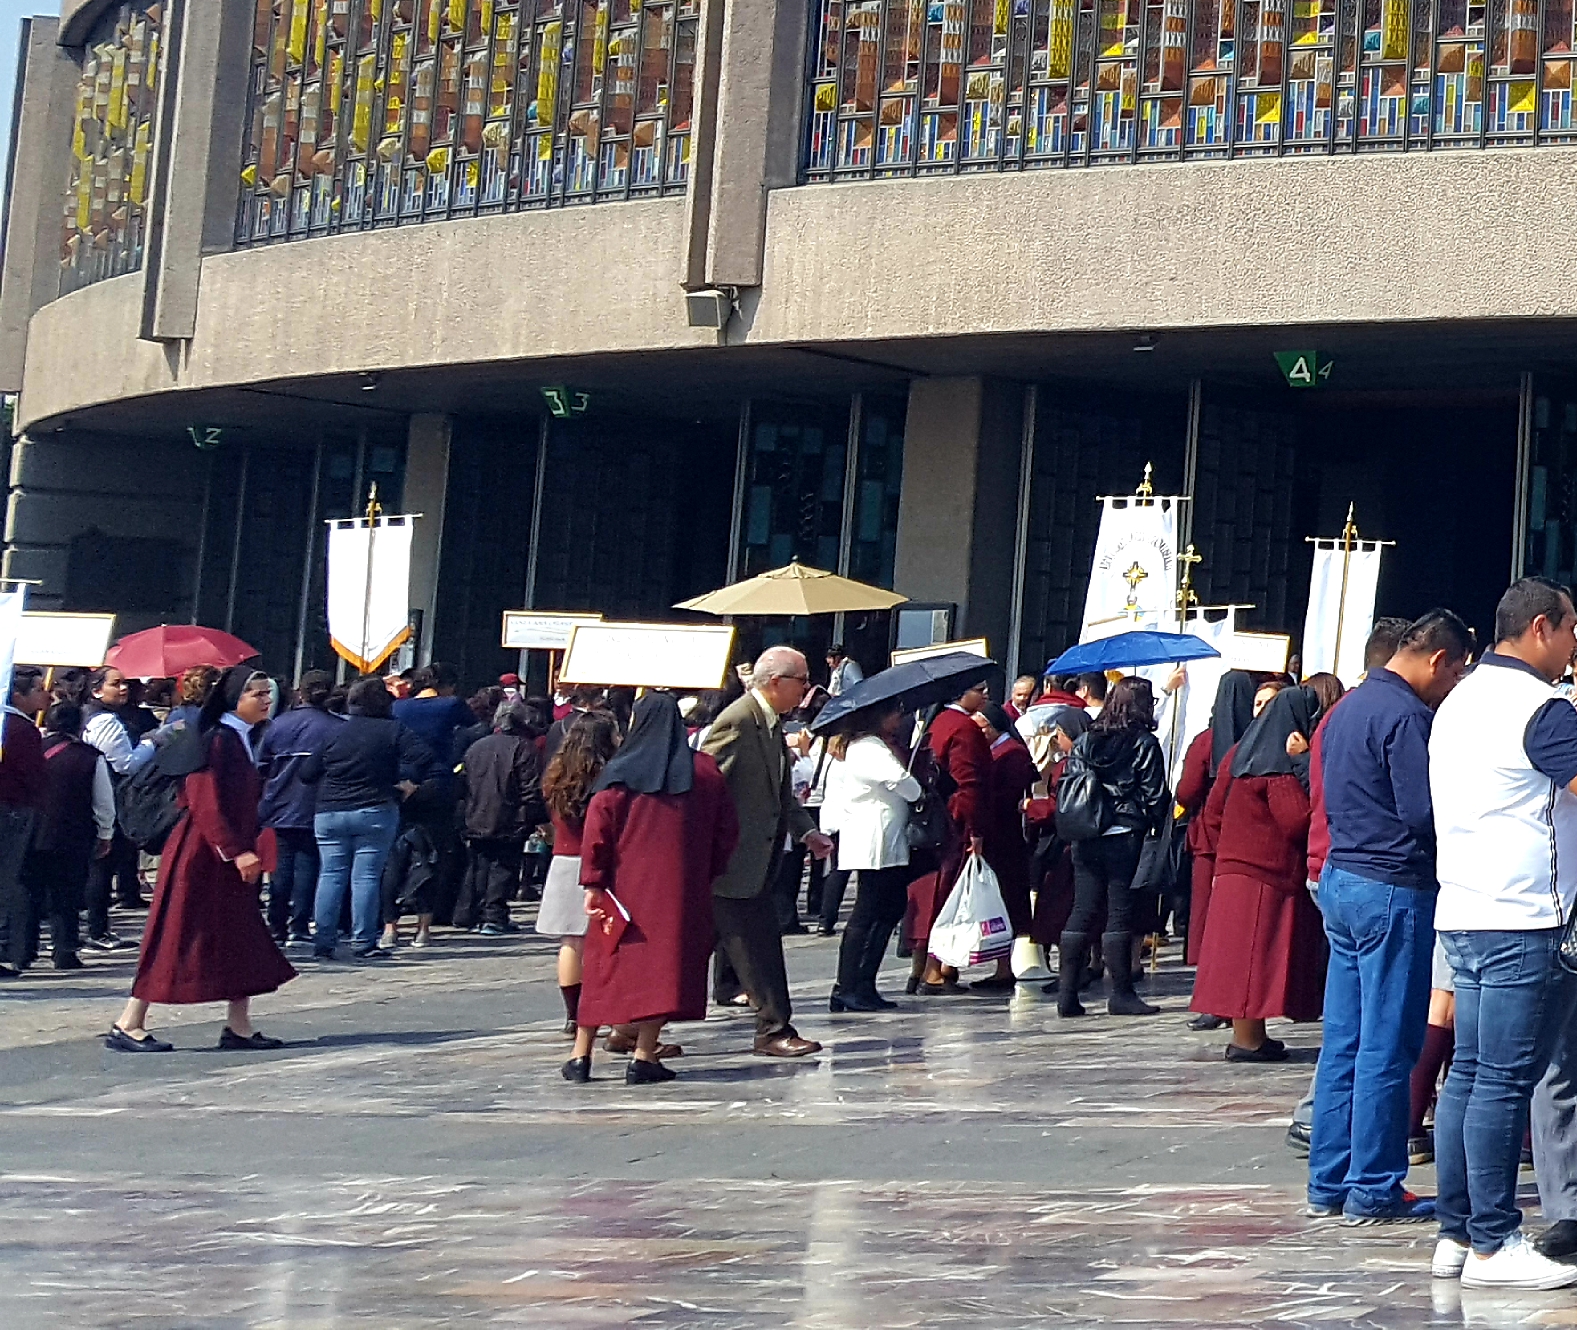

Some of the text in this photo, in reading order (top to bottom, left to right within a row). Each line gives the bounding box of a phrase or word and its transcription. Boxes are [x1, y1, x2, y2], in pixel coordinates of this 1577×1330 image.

[1290, 356, 1311, 383] 4
[1318, 360, 1334, 380] 4
[545, 390, 566, 416] 3
[571, 391, 591, 412] 3
